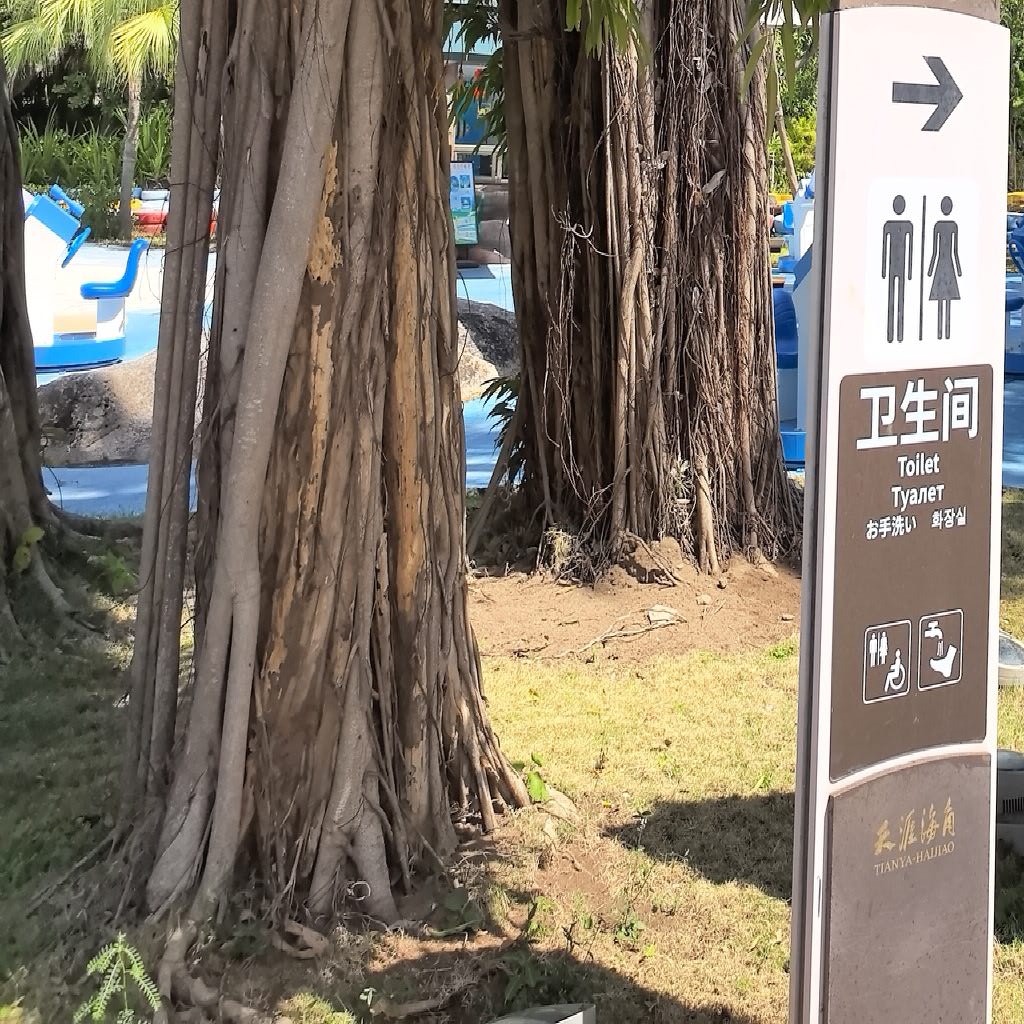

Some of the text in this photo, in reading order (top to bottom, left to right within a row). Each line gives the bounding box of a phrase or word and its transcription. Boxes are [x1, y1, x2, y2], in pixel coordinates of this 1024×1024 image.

[856, 376, 979, 450] 卫生间
[897, 453, 940, 477] Toilet
[891, 484, 945, 512] Туалет
[866, 514, 917, 540] お手洗い
[931, 506, 967, 530] 화장실
[873, 796, 956, 856] 天涯海角
